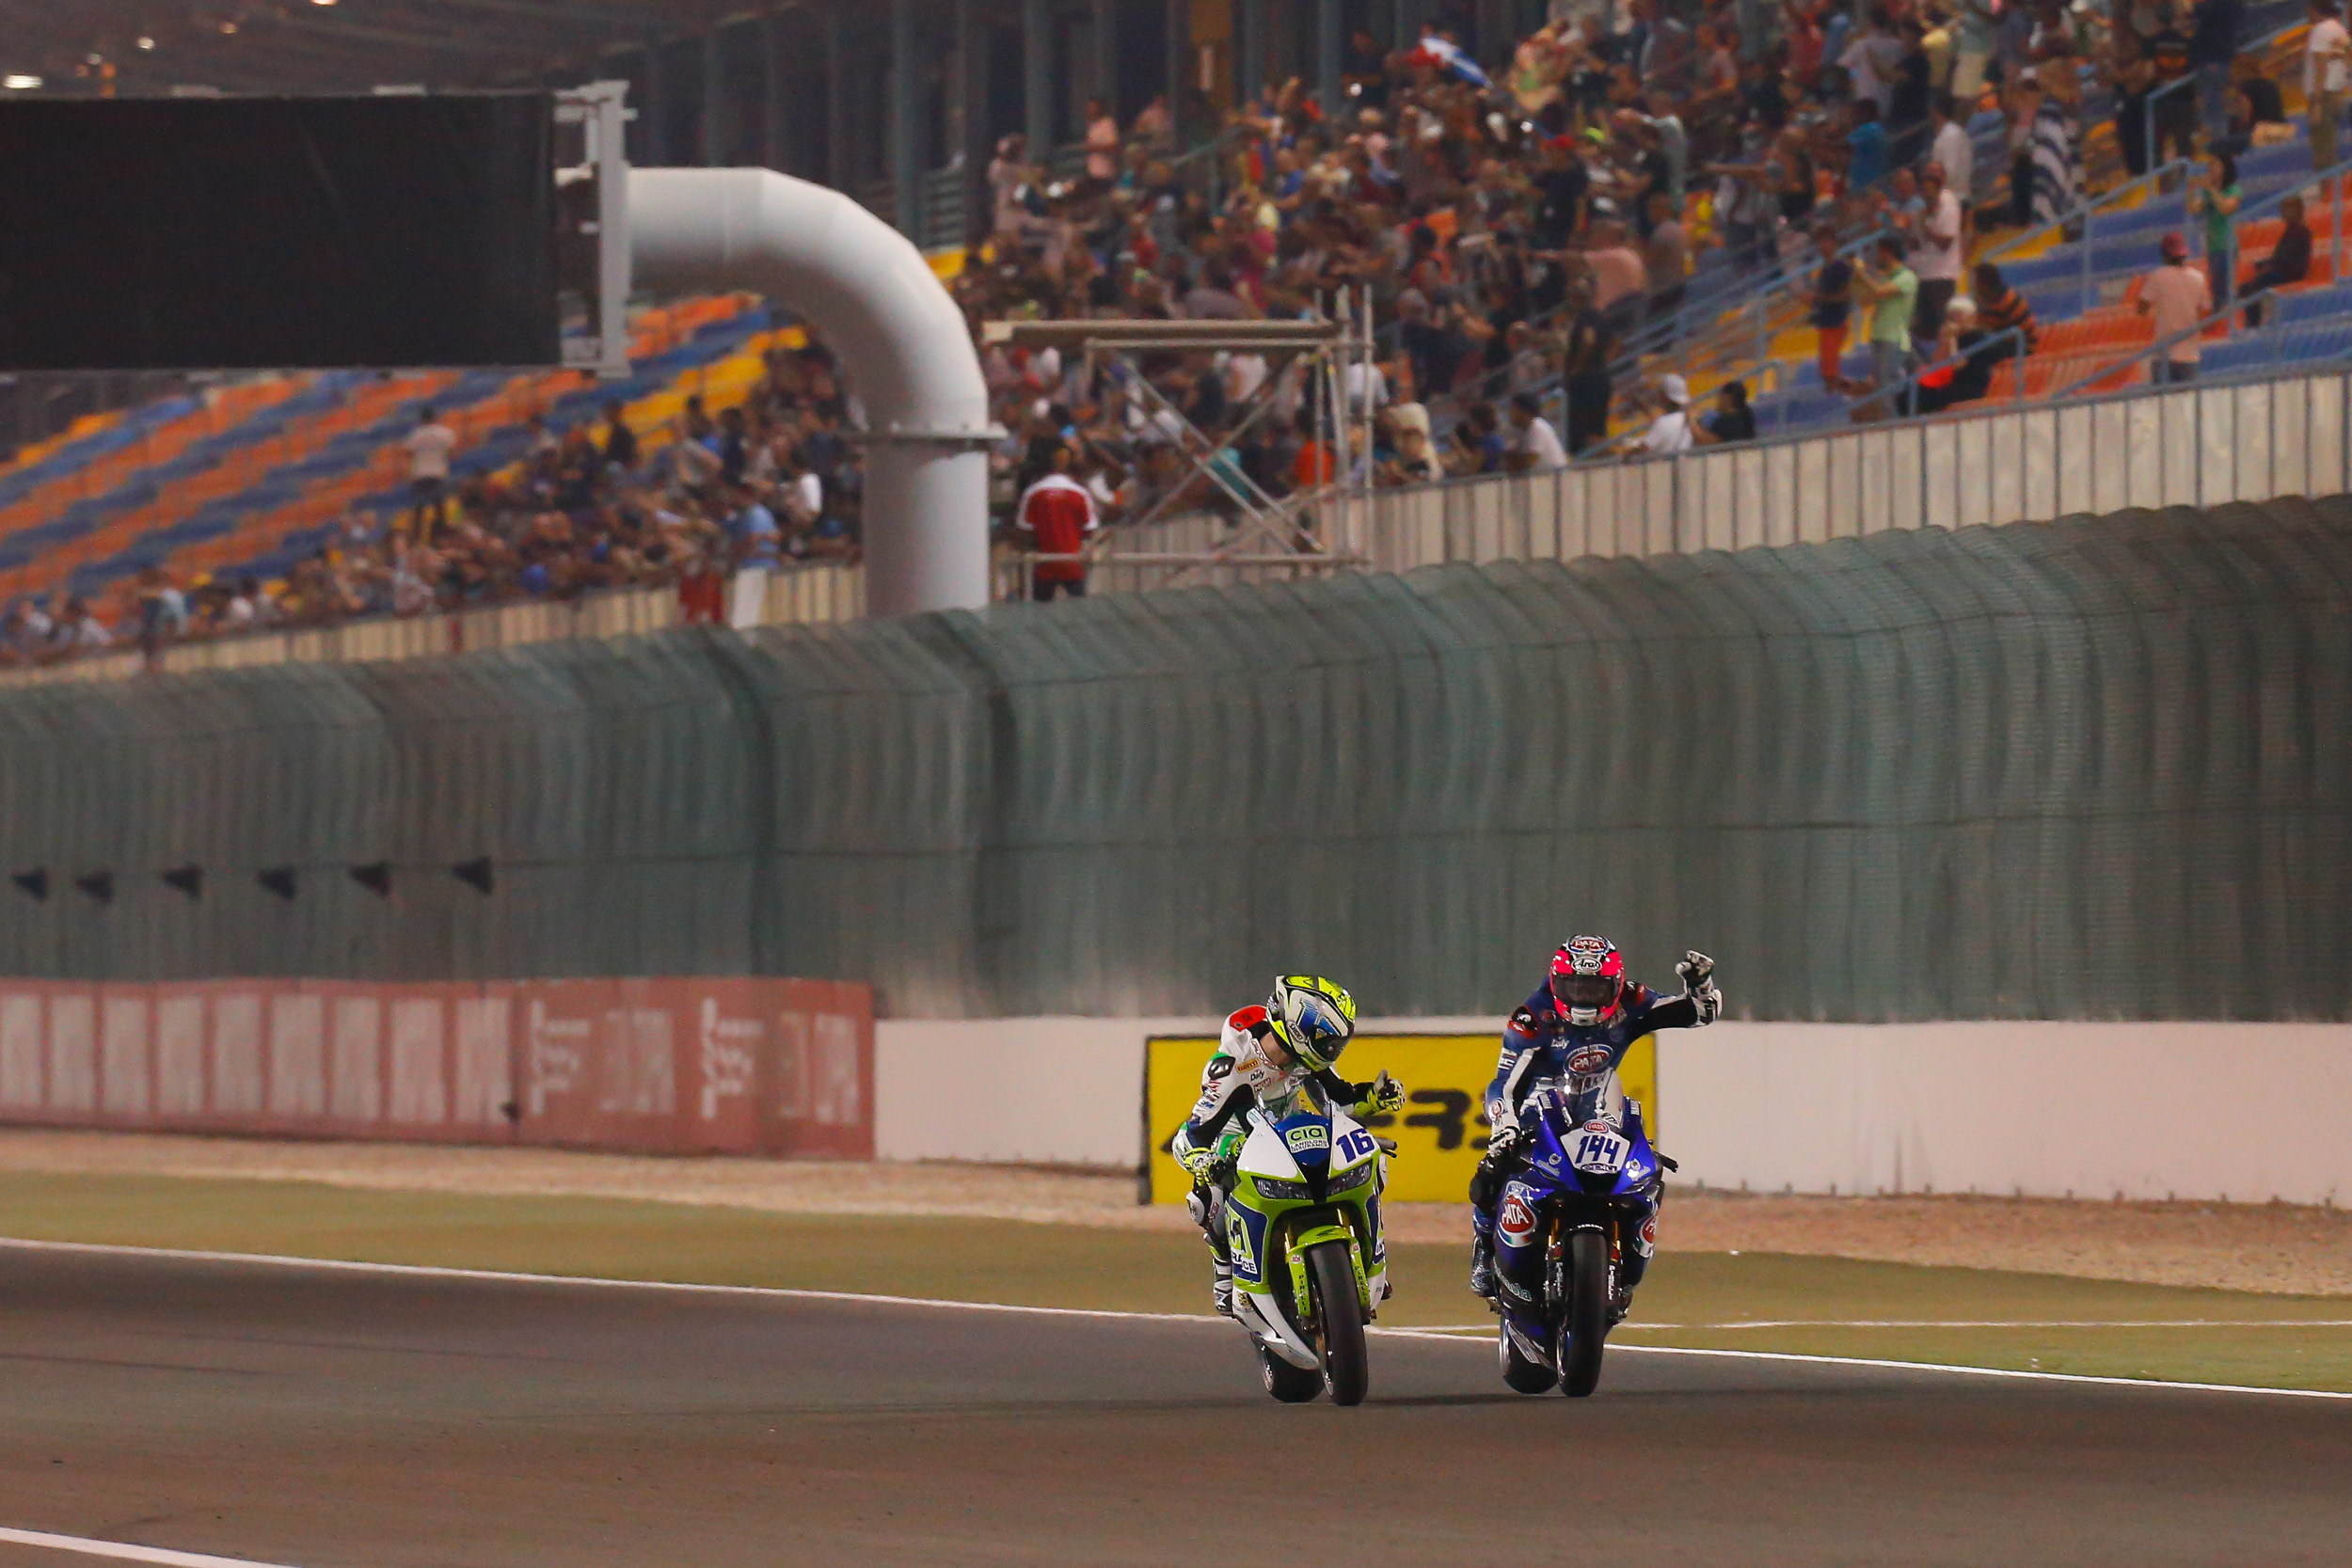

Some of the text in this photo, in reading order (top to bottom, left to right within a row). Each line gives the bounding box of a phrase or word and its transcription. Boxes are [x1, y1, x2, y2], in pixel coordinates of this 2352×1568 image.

[1575, 939, 1600, 950] PATA
[1574, 1053, 1603, 1069] PATA
[1336, 1129, 1375, 1164] 16
[1575, 1134, 1621, 1164] 144
[1298, 1275, 1307, 1311] PIRELLI
[1355, 1266, 1368, 1301] PIRELLI
